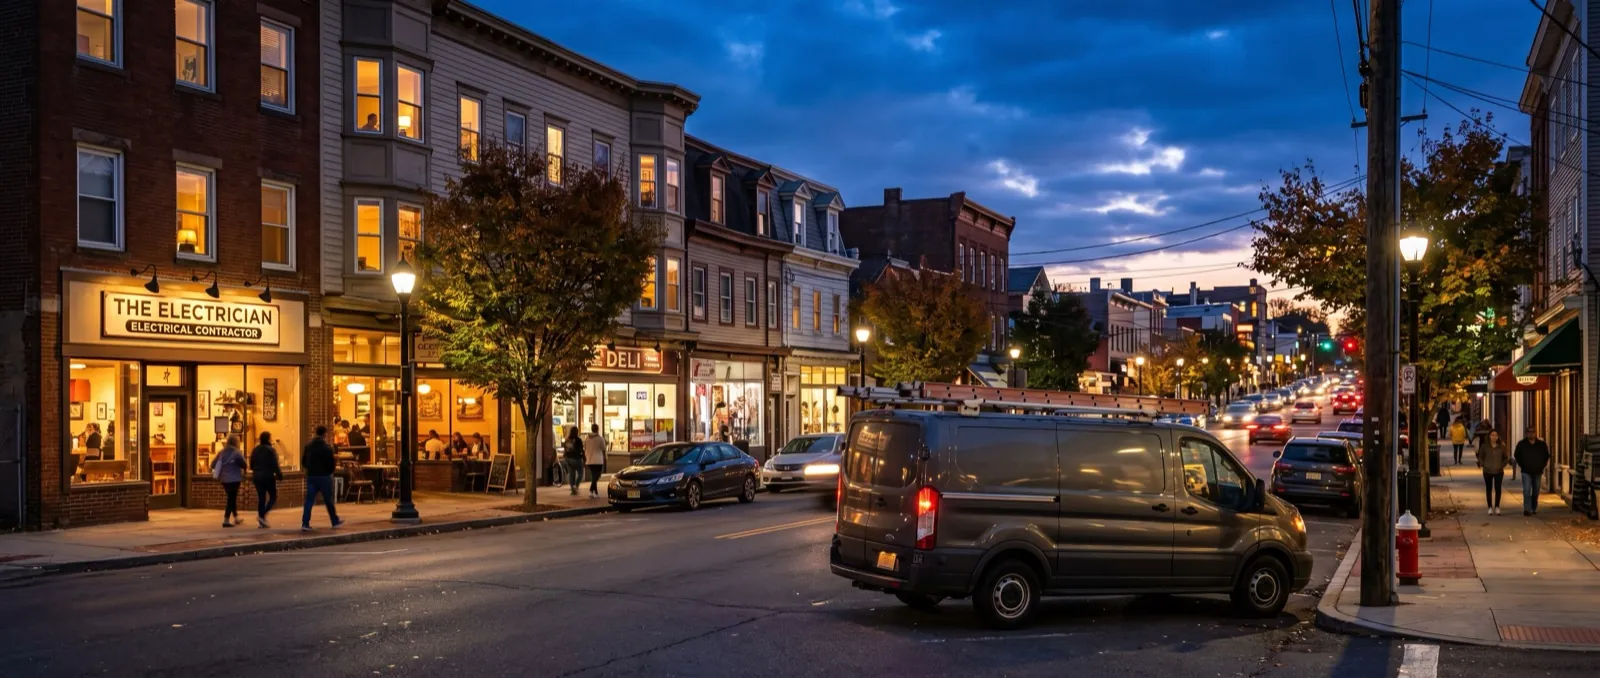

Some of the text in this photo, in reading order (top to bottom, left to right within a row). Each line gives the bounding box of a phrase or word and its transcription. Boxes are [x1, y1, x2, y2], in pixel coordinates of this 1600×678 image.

[114, 298, 272, 325] THE ELECTRICIAN
[131, 321, 258, 339] ELECTRICAL CONTRACTOR
[606, 350, 641, 369] DELI
